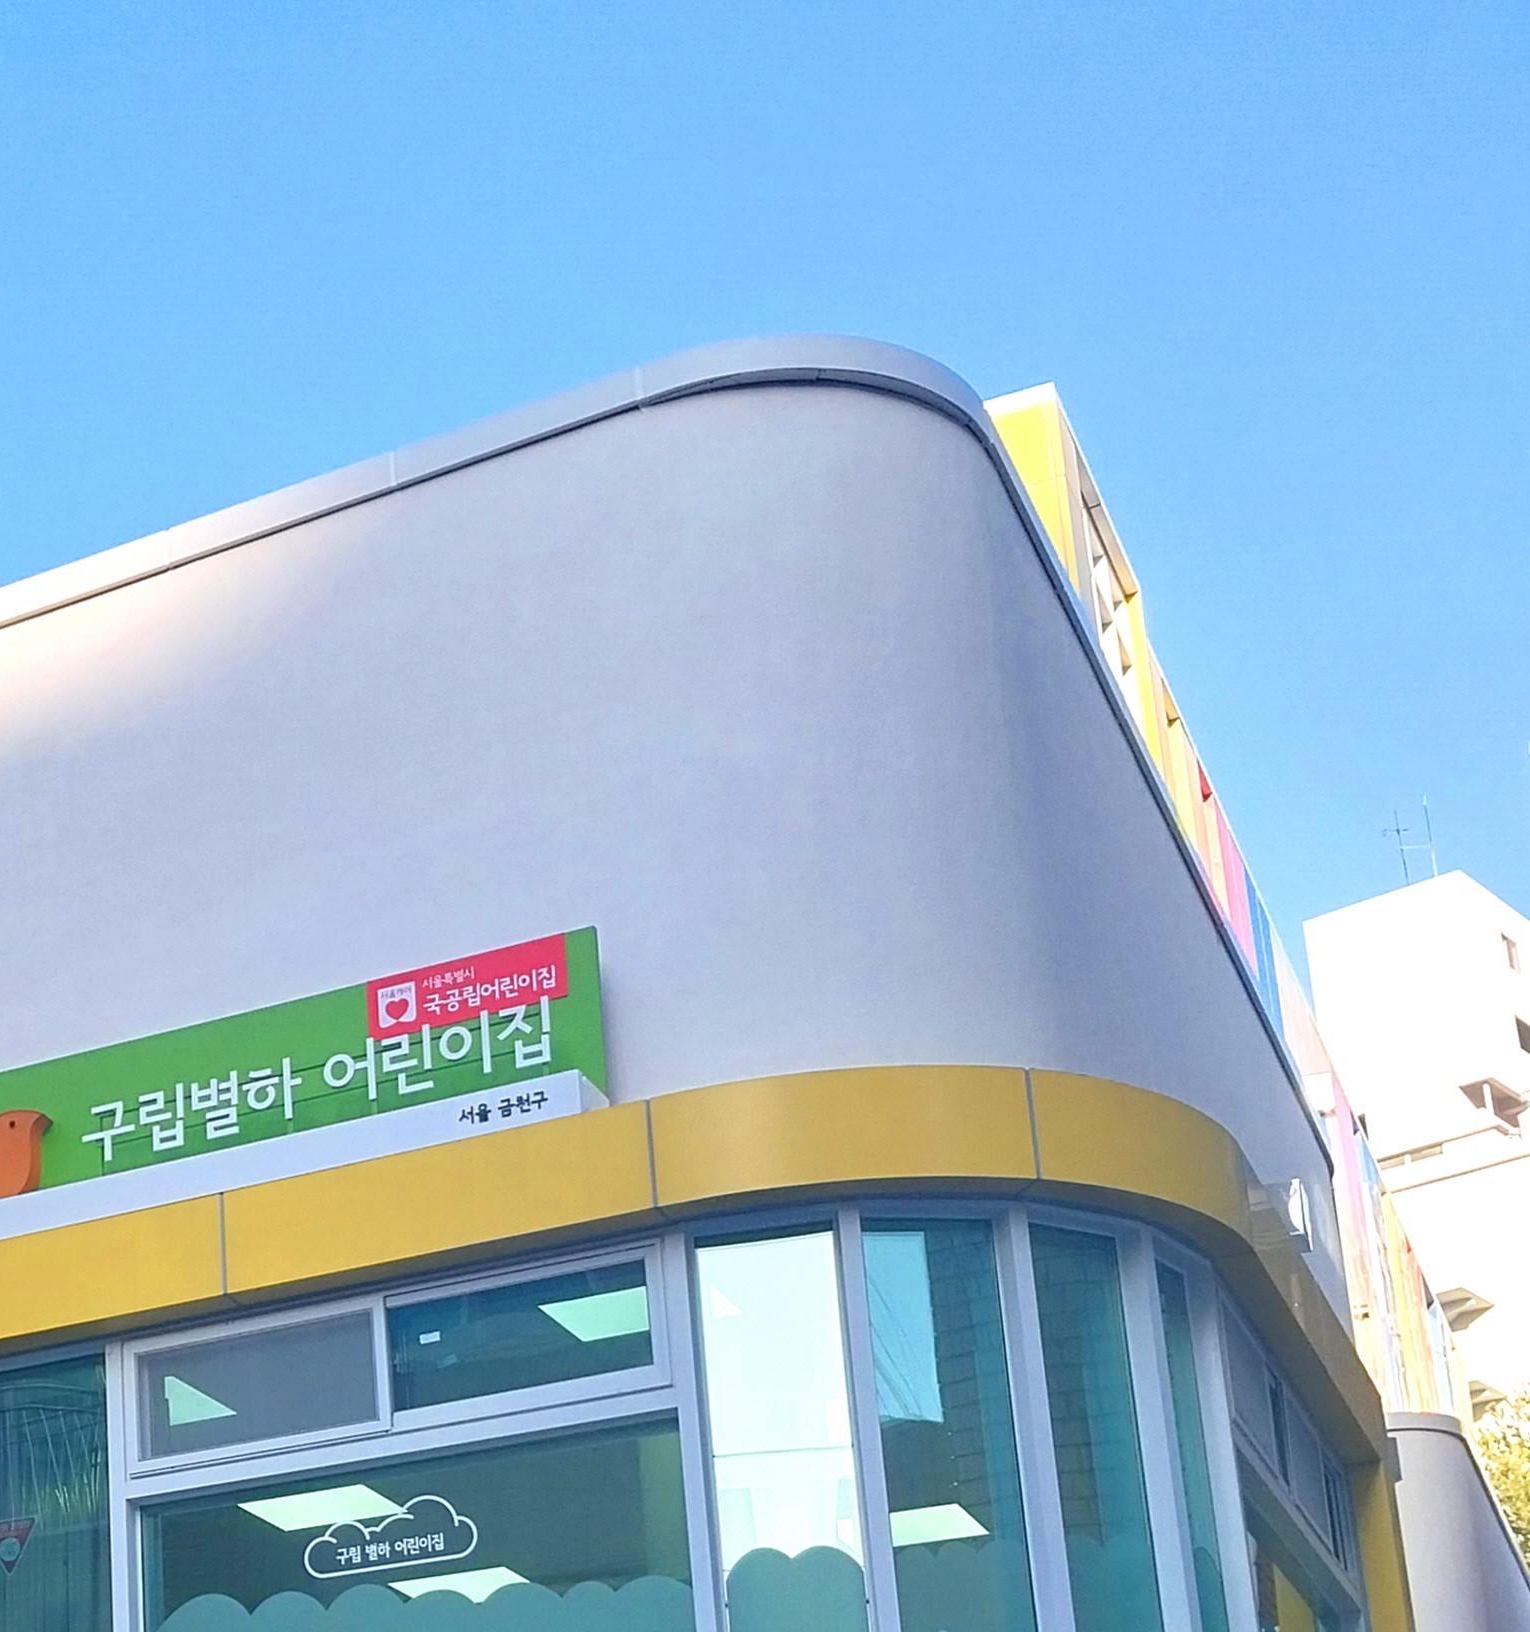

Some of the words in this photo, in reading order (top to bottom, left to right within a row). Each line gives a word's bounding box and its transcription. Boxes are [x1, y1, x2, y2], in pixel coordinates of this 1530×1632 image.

[422, 966, 475, 990] 서울특별시
[422, 964, 557, 1015] 국공립어린이집
[81, 1056, 303, 1162] 구립별하
[322, 994, 552, 1100] 어린이집
[458, 1103, 492, 1125] 서울
[497, 1090, 549, 1118] 금천구
[335, 1545, 362, 1566] 구립
[365, 1541, 391, 1561] 별하
[394, 1532, 445, 1556] 어린이집
